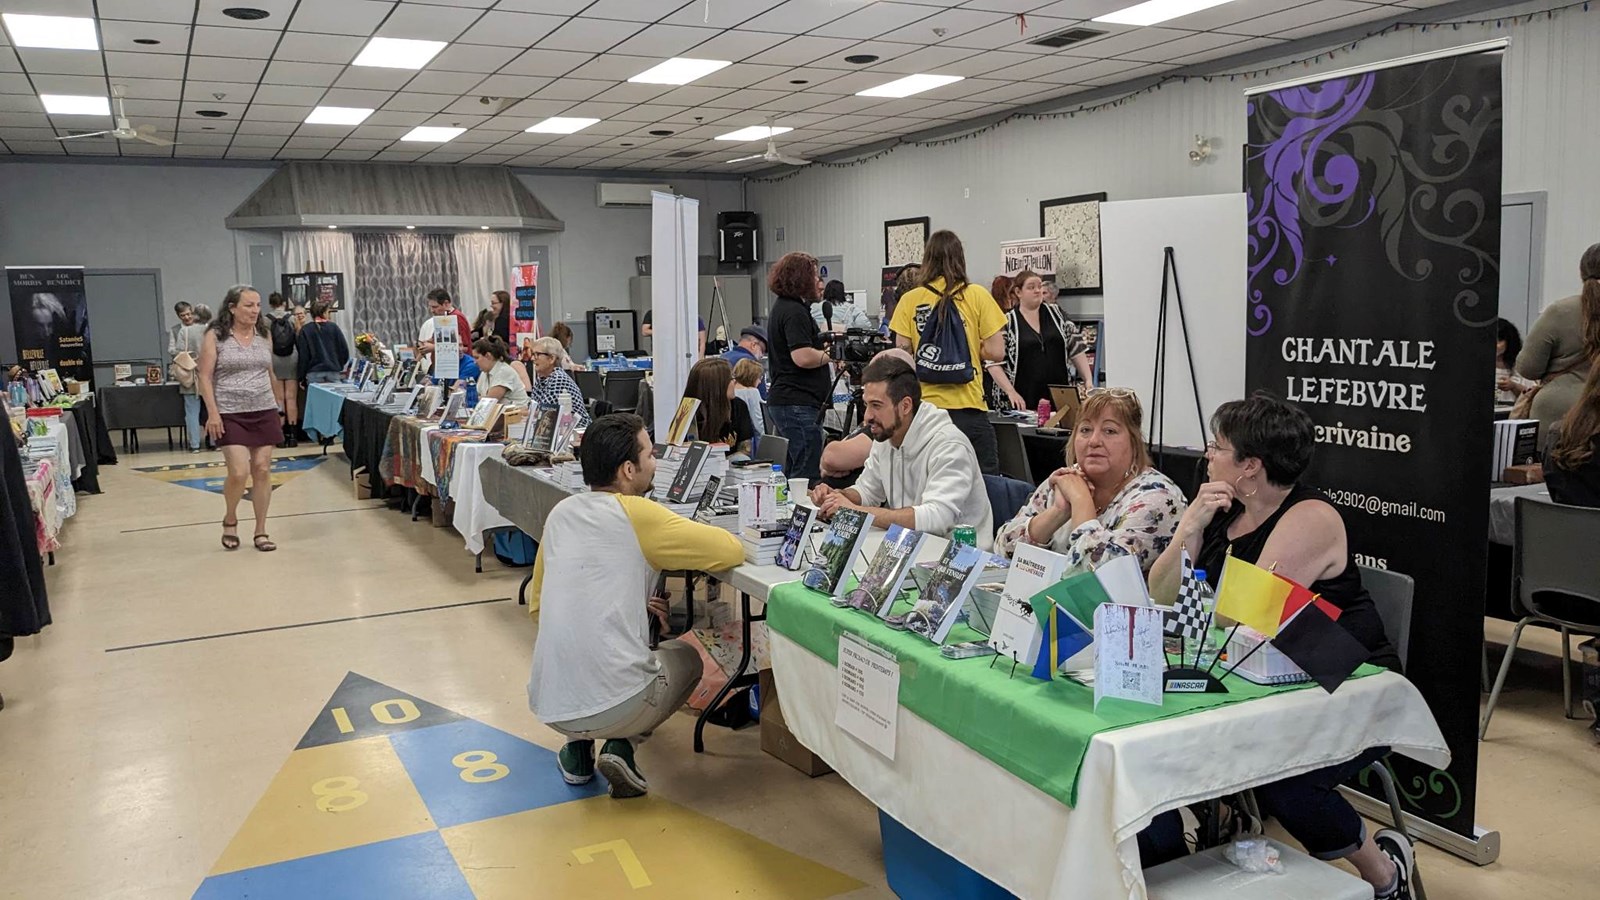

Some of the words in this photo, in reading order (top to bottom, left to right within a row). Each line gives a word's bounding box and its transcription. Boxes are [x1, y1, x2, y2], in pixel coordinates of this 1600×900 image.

[1017, 246, 1043, 254] ÉDITIONS
[917, 359, 966, 372] SKECHERS
[1281, 337, 1436, 370] CHANTALE
[1286, 376, 1427, 412] LEFEBVRE
[1314, 421, 1411, 453] crivaine
[1353, 552, 1388, 571] ans
[1176, 681, 1205, 689] NASCAR
[331, 699, 422, 734] 10
[451, 750, 511, 783] 8
[311, 775, 368, 812] 8
[571, 838, 653, 890] 7
